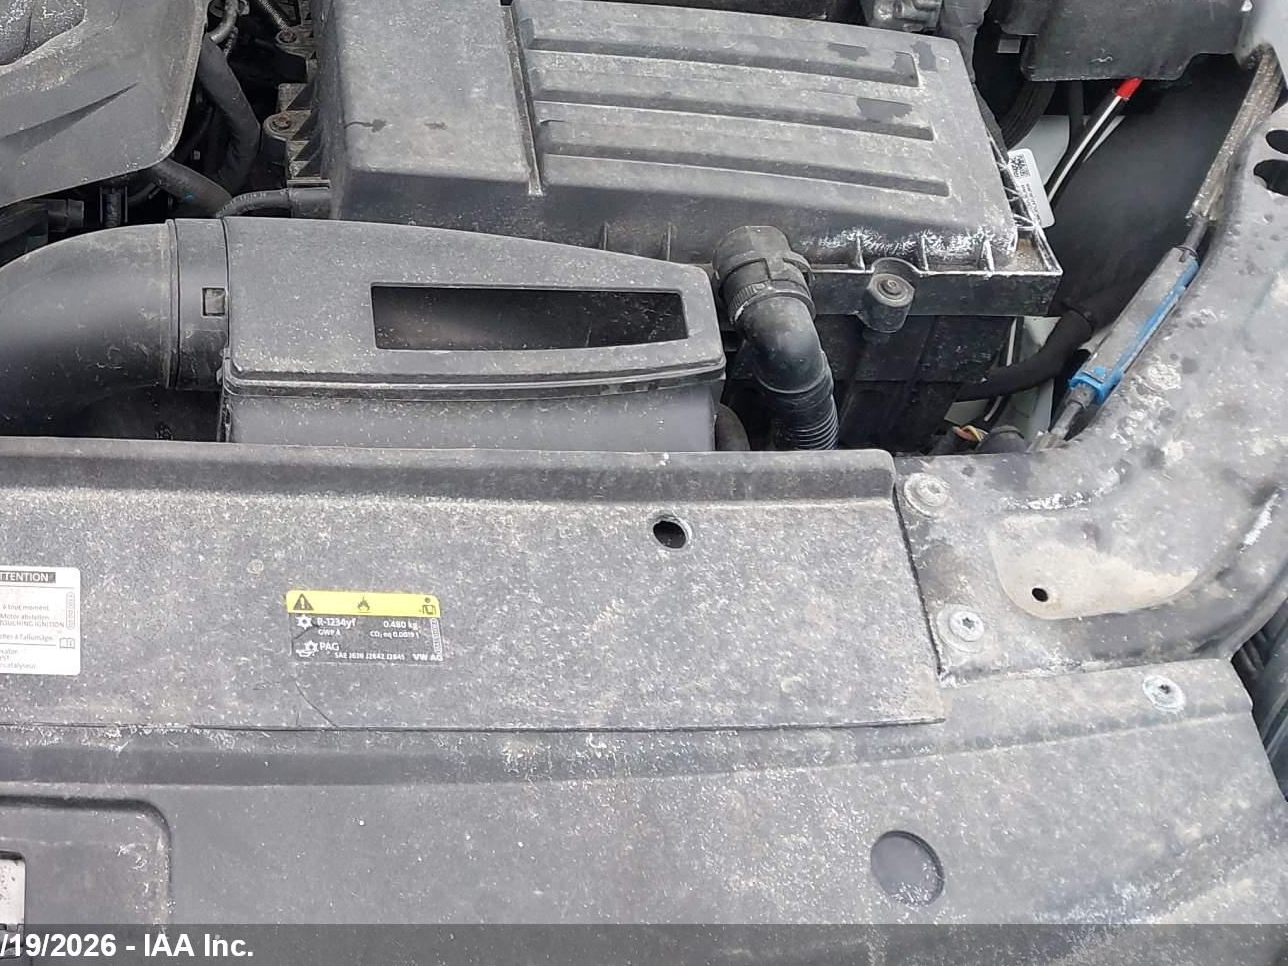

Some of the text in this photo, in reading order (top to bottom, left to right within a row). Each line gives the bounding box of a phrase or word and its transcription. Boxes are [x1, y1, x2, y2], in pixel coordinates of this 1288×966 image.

[317, 617, 357, 629] R-1234yf
[320, 642, 340, 651] PAG
[412, 653, 428, 661] VW
